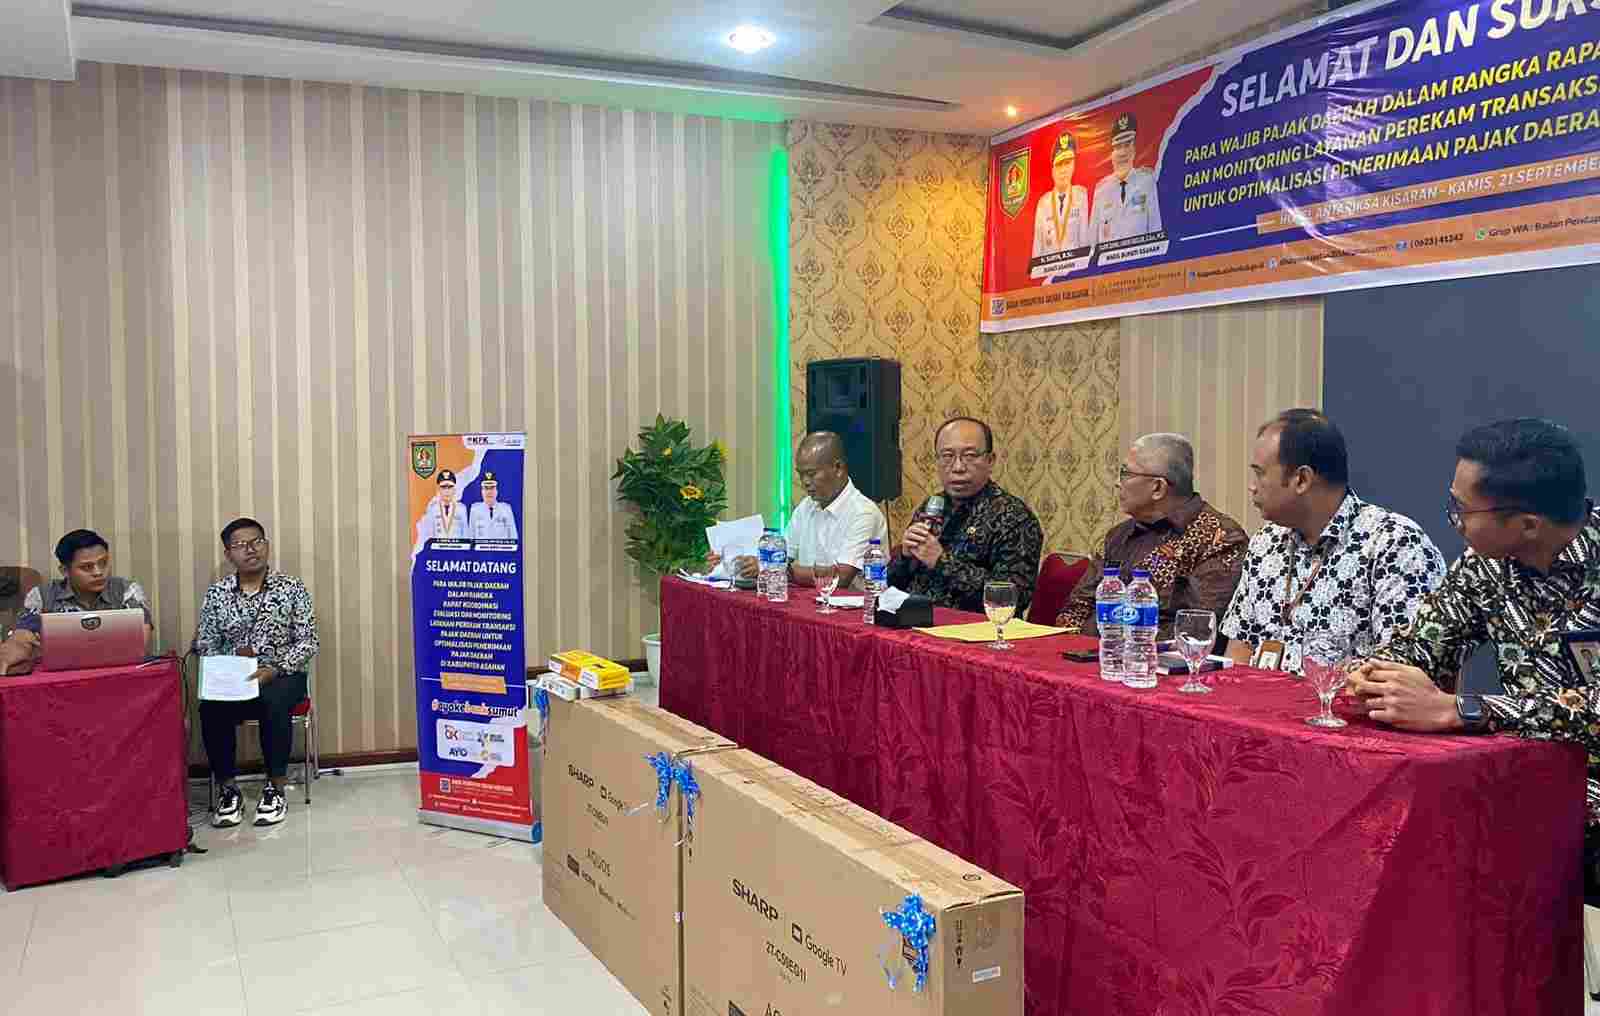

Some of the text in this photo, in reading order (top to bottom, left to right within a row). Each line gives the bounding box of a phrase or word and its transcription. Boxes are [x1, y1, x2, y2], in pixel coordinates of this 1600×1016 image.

[1221, 0, 1600, 117] SELAMAT DAN SU
[1184, 75, 1600, 189] DAN MONITORING LAYANAN PEREKAM TRANSAKS
[1185, 146, 1217, 164] PARA
[1220, 130, 1261, 155] WAJIB
[1263, 115, 1309, 143] PAJAK
[1311, 98, 1377, 131] DAERAH
[1381, 79, 1448, 113] DALAM
[1452, 56, 1541, 95] RANGKA
[1183, 192, 1227, 213] UNTUK
[1228, 164, 1328, 202] OPTIMALISASI
[1331, 140, 1449, 181] PENERIMAAN
[1454, 125, 1520, 157] PAJAK
[1382, 185, 1438, 208] KISARAN
[426, 560, 517, 574] SELAMAT DATANG
[732, 878, 848, 976] SHARP Google TV
